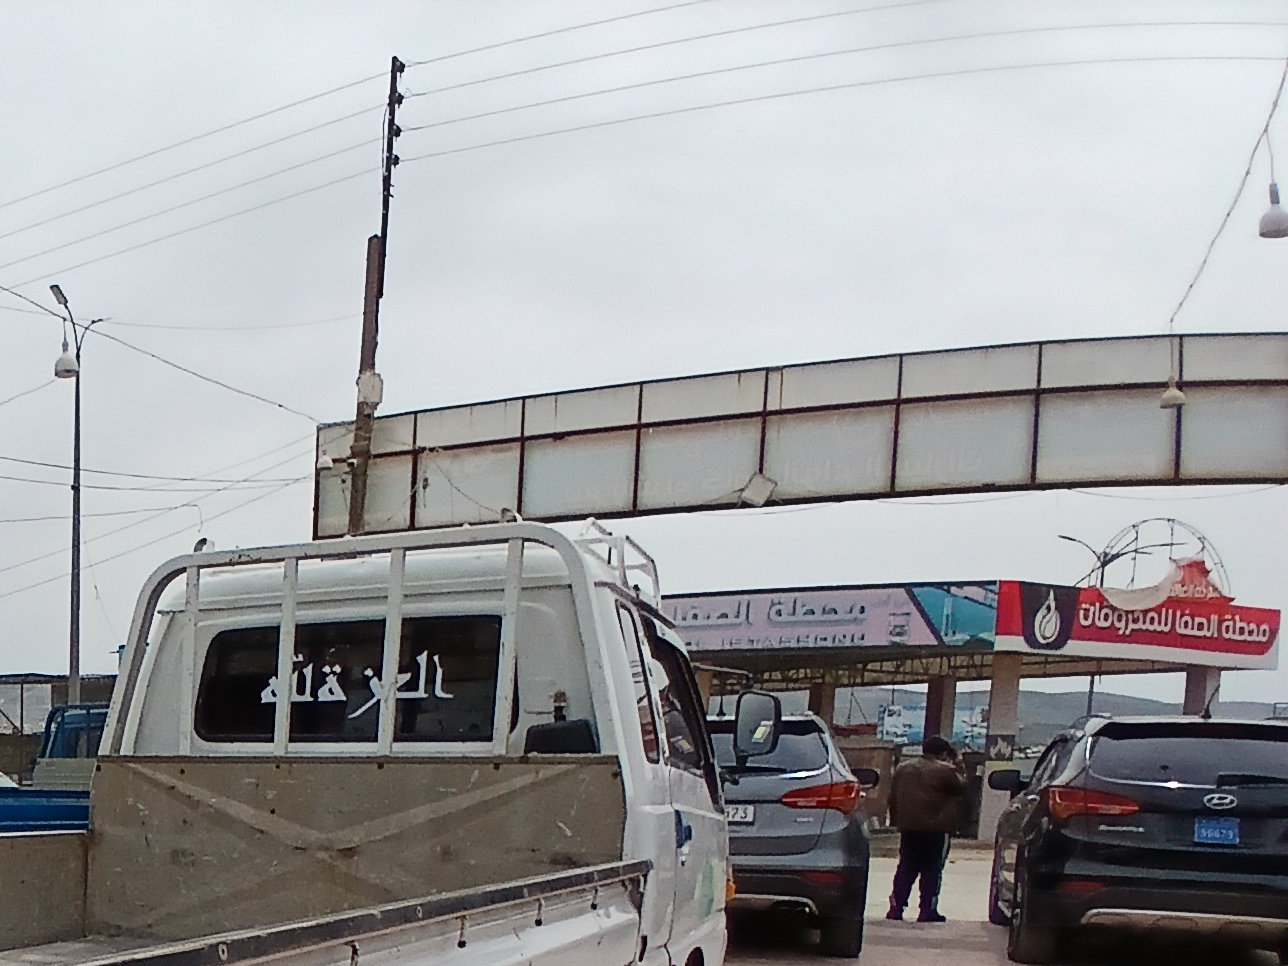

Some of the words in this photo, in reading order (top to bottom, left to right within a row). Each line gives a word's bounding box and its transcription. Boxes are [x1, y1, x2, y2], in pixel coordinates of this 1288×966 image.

[1078, 602, 1172, 635] للمحروقات
[1175, 608, 1219, 638] الصفا
[1221, 614, 1270, 642] محطة
